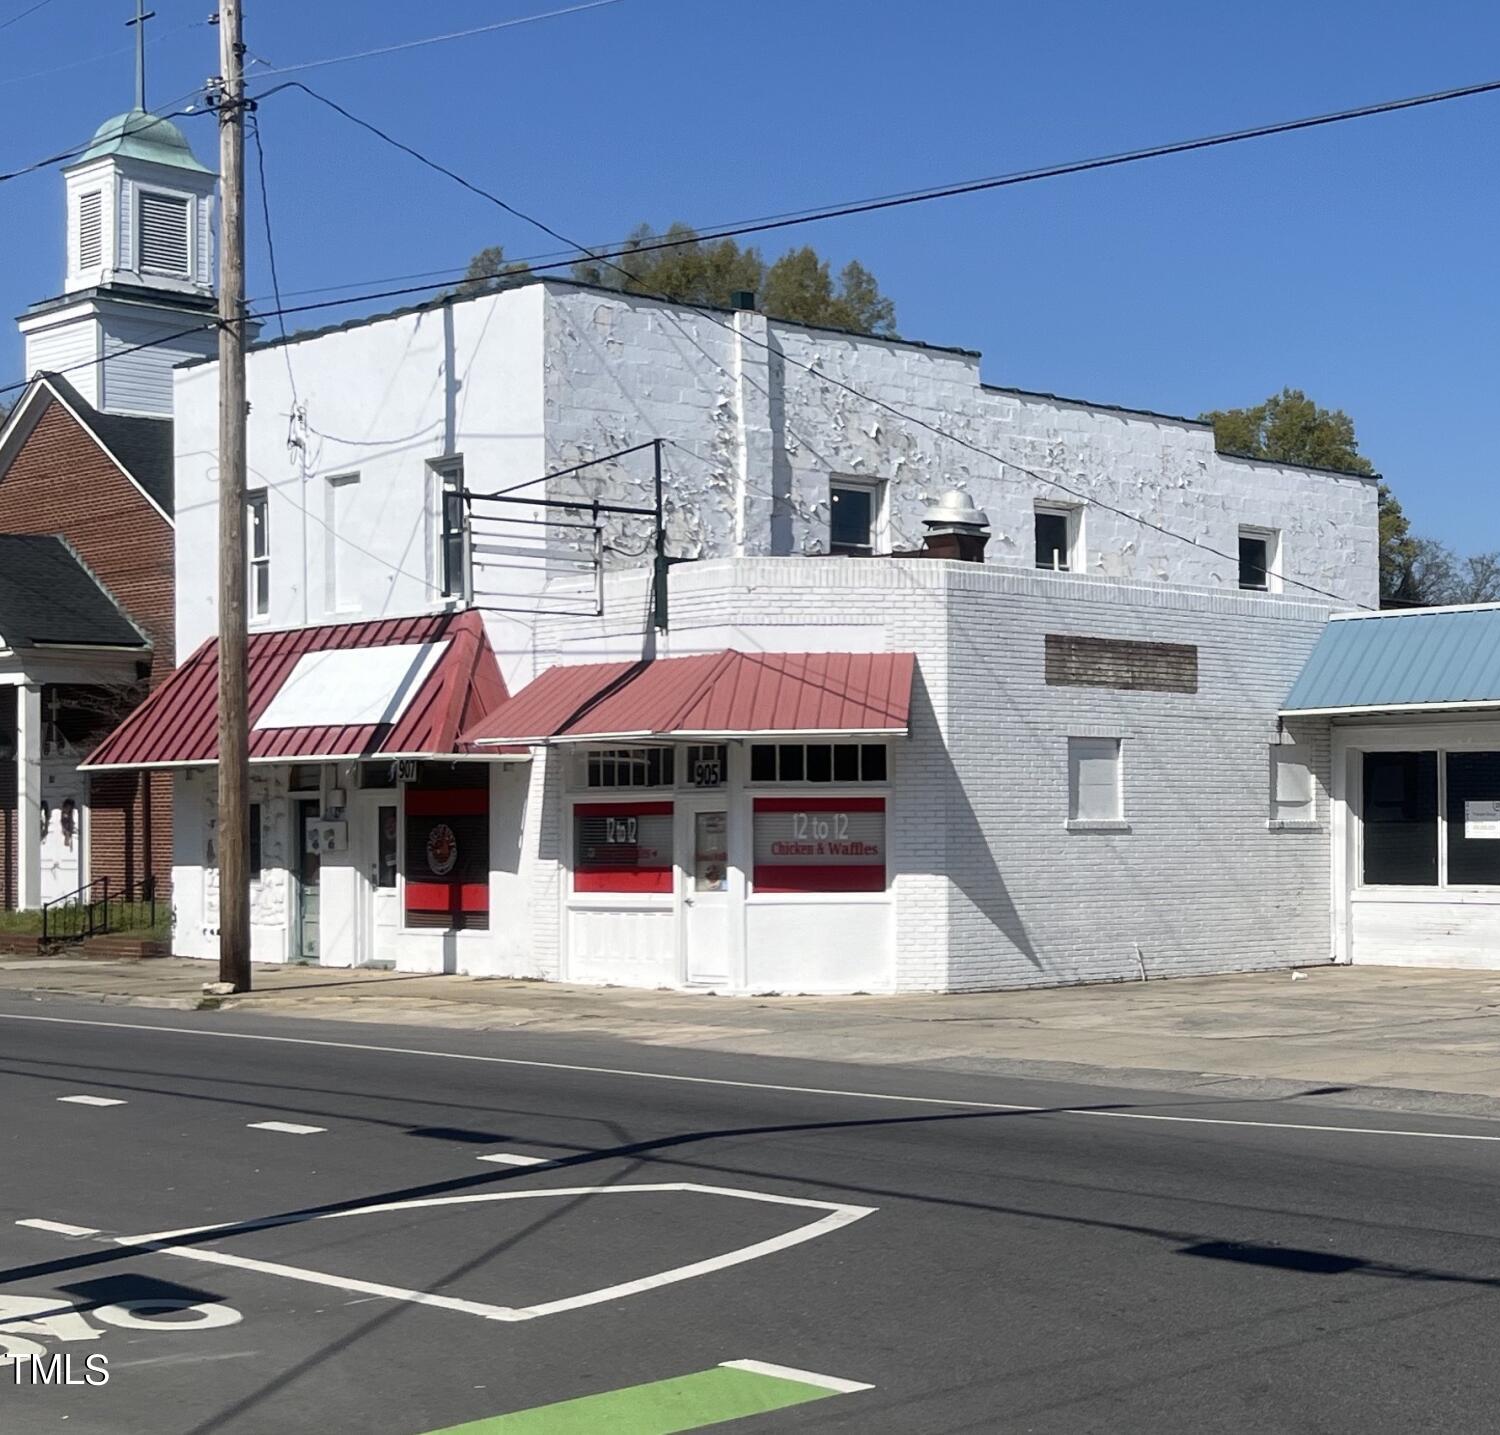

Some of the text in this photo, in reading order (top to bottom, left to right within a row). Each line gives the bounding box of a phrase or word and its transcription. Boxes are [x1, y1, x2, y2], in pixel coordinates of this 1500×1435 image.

[399, 760, 415, 779] 907
[695, 763, 719, 786] 905
[606, 817, 637, 843] 12 to 12
[793, 813, 849, 840] 12 to 12
[771, 841, 879, 856] Chicken & Waffles
